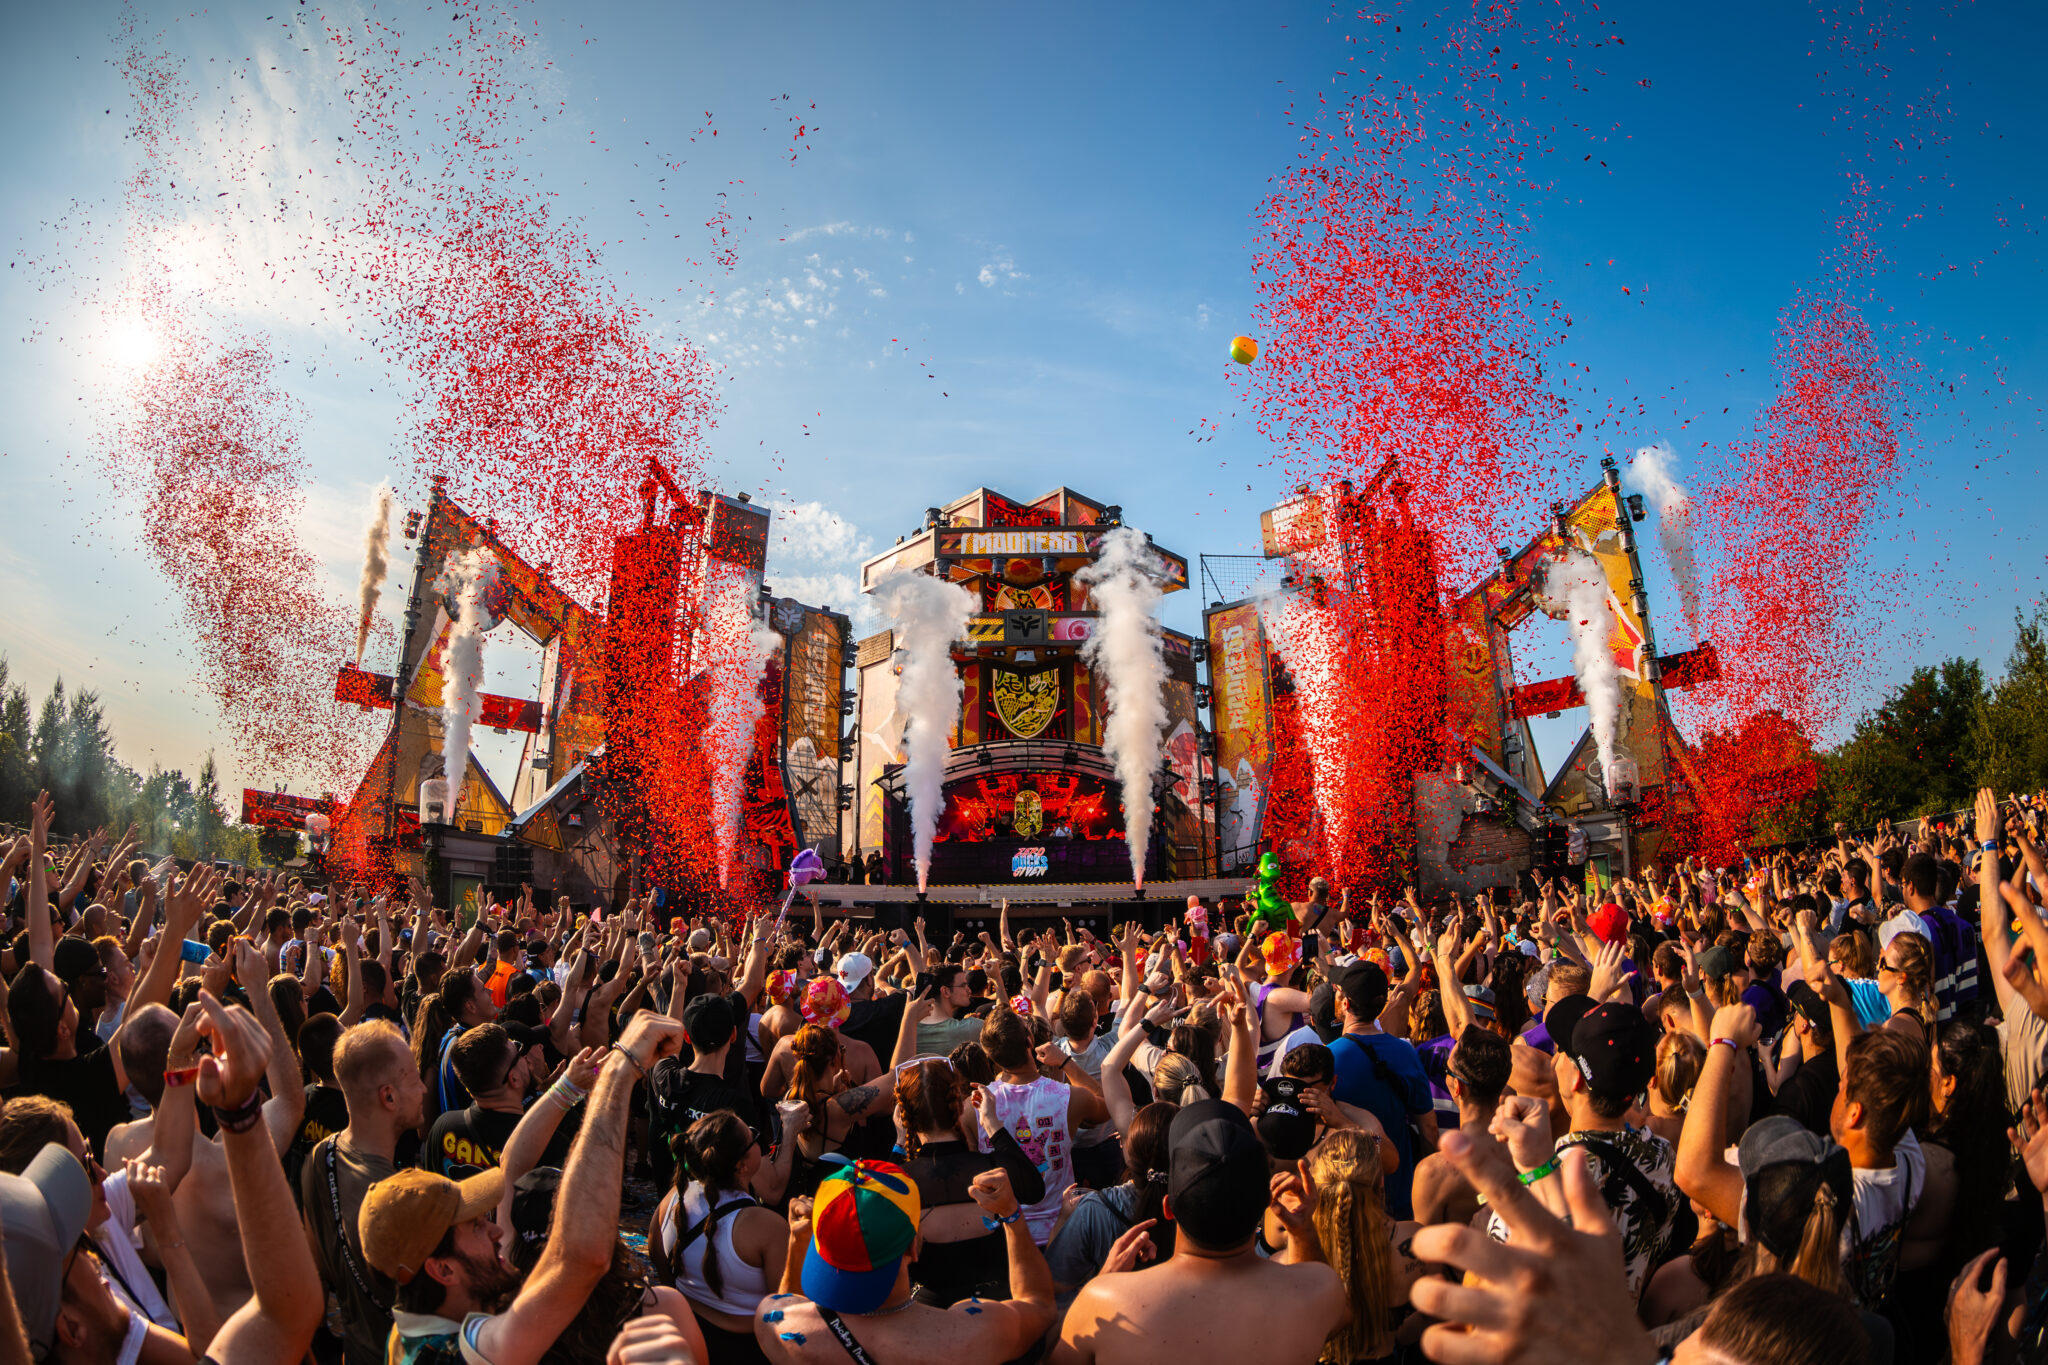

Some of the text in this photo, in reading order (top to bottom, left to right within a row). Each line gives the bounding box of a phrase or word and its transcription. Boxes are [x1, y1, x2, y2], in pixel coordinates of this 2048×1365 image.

[973, 531, 1077, 554] MADNESS
[1221, 625, 1250, 730] MADNESS
[1014, 846, 1046, 857] ZERO
[1012, 867, 1047, 878] GIVEN
[328, 1171, 340, 1221] adidas
[343, 1244, 369, 1294] adidas
[830, 1318, 870, 1365] Mickey Mou
